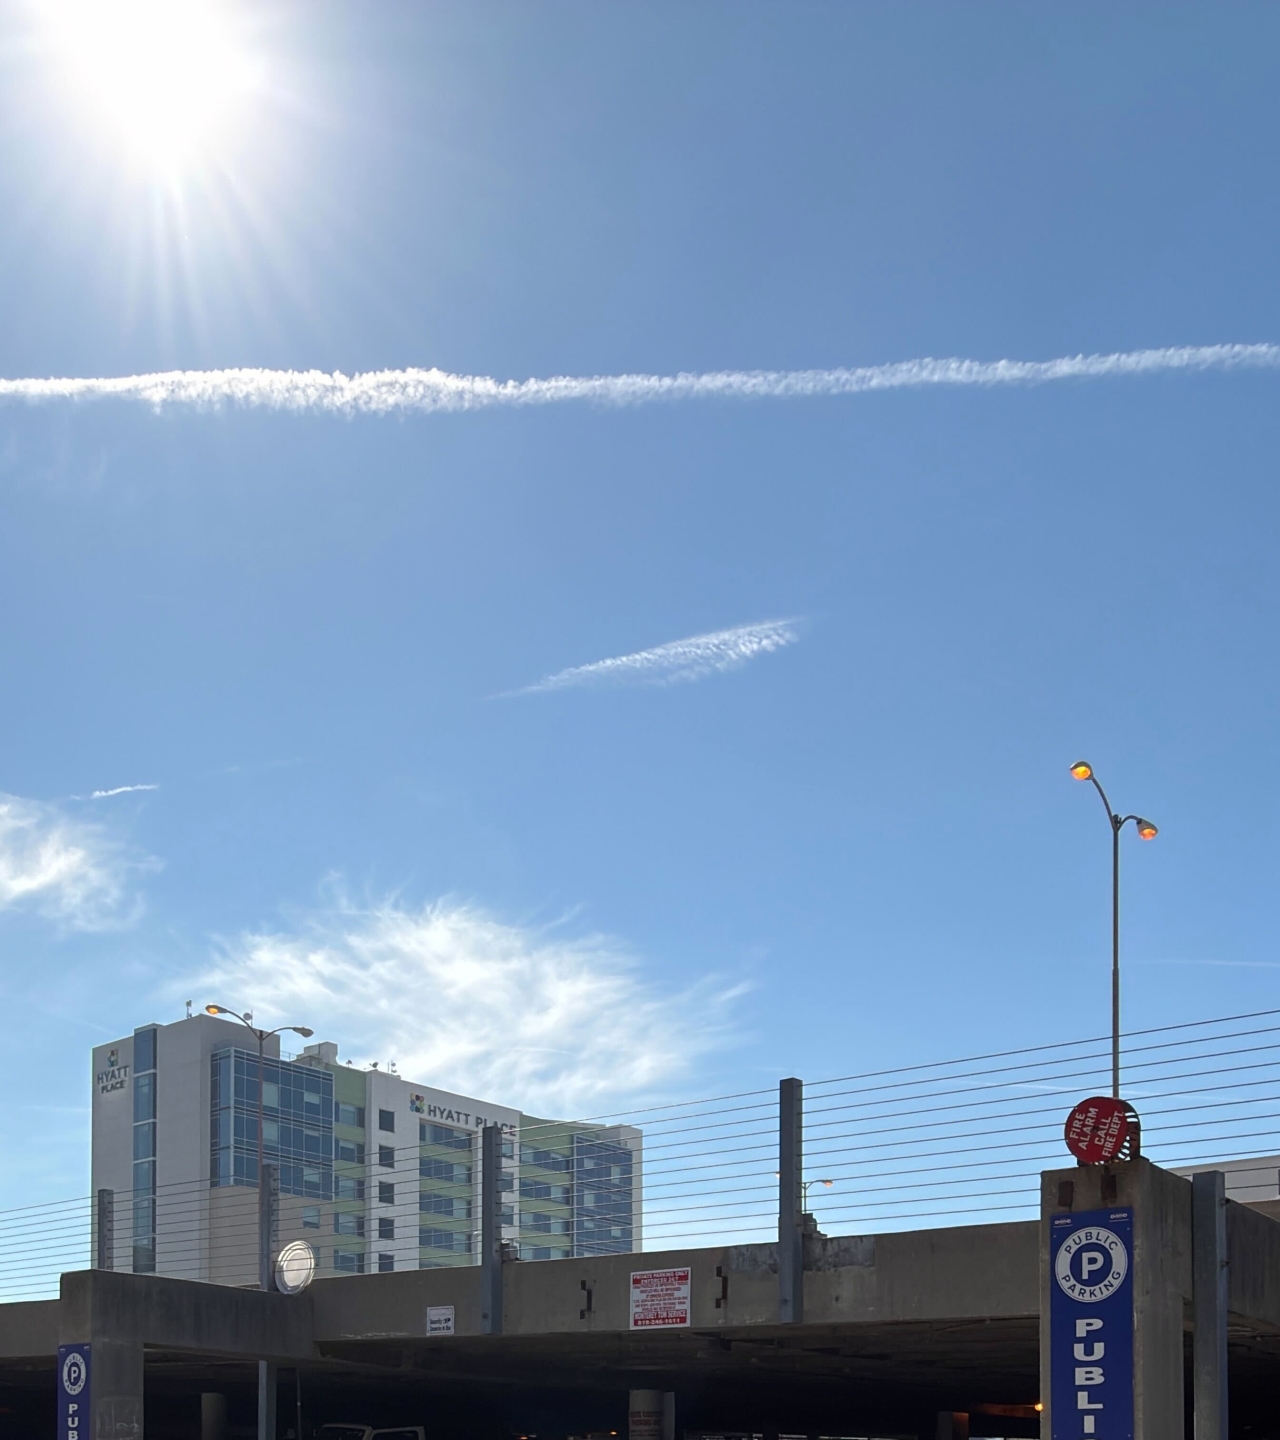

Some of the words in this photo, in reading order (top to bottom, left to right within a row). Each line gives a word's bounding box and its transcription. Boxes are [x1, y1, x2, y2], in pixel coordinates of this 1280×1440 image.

[97, 1065, 129, 1084] HYATT
[101, 1080, 126, 1094] PLACE
[428, 1104, 470, 1125] HYATT
[1070, 1112, 1085, 1139] FIRE
[1078, 1107, 1099, 1150] ALARM
[1094, 1116, 1111, 1146] CALL
[1102, 1136, 1116, 1157] FIRE
[1064, 1231, 1118, 1255] PUBLIC
[1081, 1251, 1104, 1280] P
[1061, 1270, 1121, 1298] PARKING
[668, 1309, 686, 1318] SERVICE
[70, 1366, 79, 1383] P
